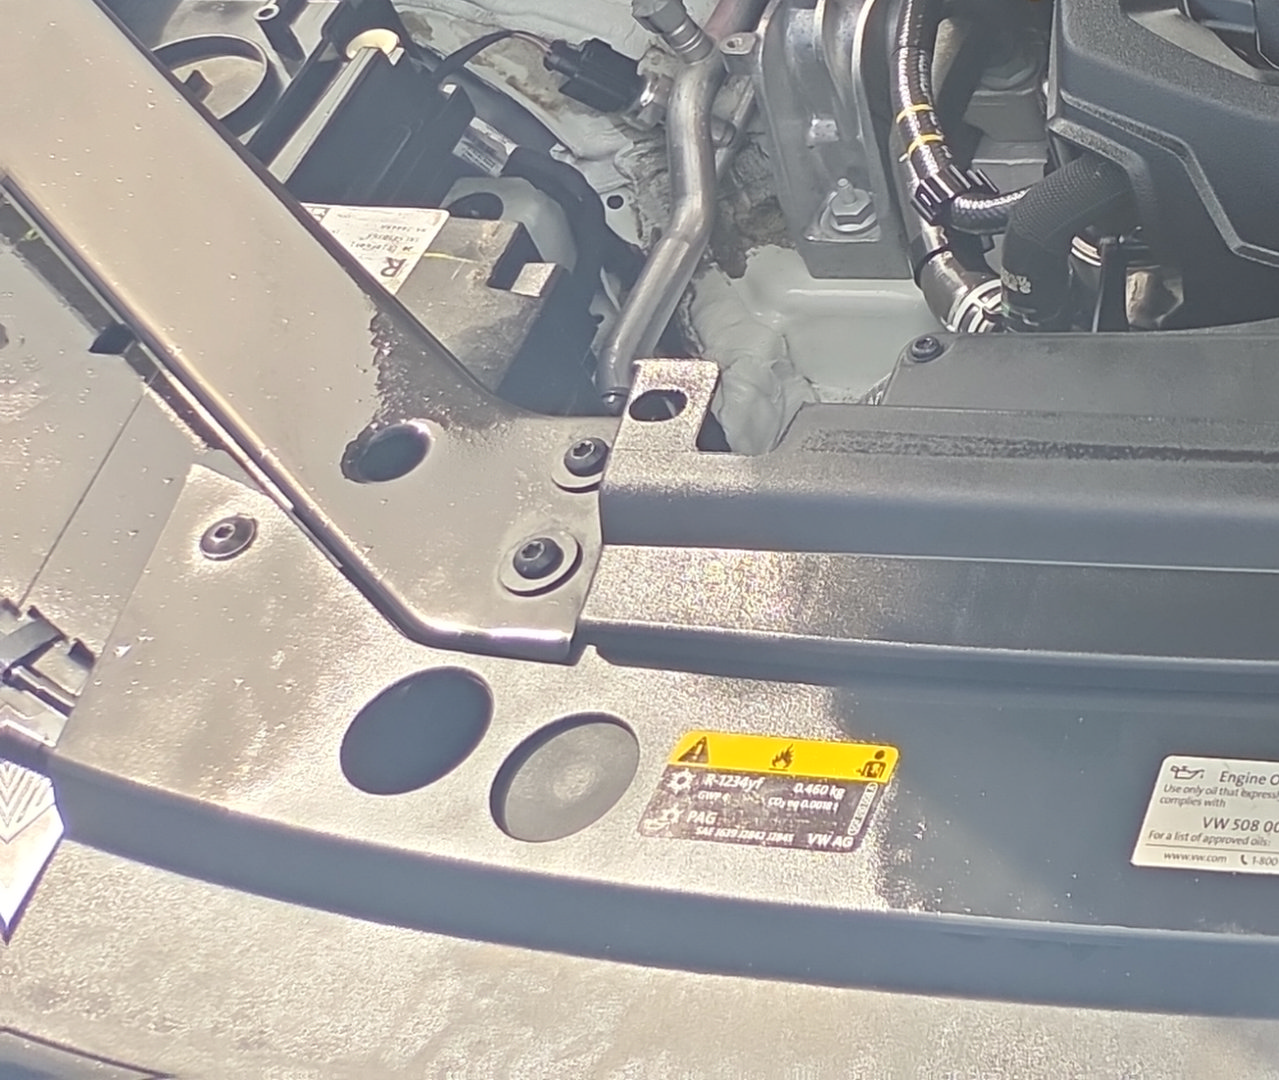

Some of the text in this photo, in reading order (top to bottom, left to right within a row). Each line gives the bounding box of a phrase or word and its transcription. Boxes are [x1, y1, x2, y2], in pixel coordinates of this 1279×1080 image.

[1219, 771, 1266, 787] Engine
[704, 773, 845, 800] R-1234yf 0.460 kg
[1164, 784, 1181, 793] Use
[1183, 785, 1205, 796] only
[1205, 787, 1217, 795] oil
[1219, 787, 1239, 797] that
[1160, 797, 1226, 807] complies with
[686, 811, 717, 824] PAG
[1202, 817, 1230, 830] VW
[1232, 818, 1259, 831] 508
[807, 833, 853, 848] VW AG
[1149, 830, 1164, 839] For
[1175, 832, 1189, 841] list
[1190, 833, 1201, 842] of
[1202, 835, 1249, 846] approved
[1251, 837, 1271, 846] oils:
